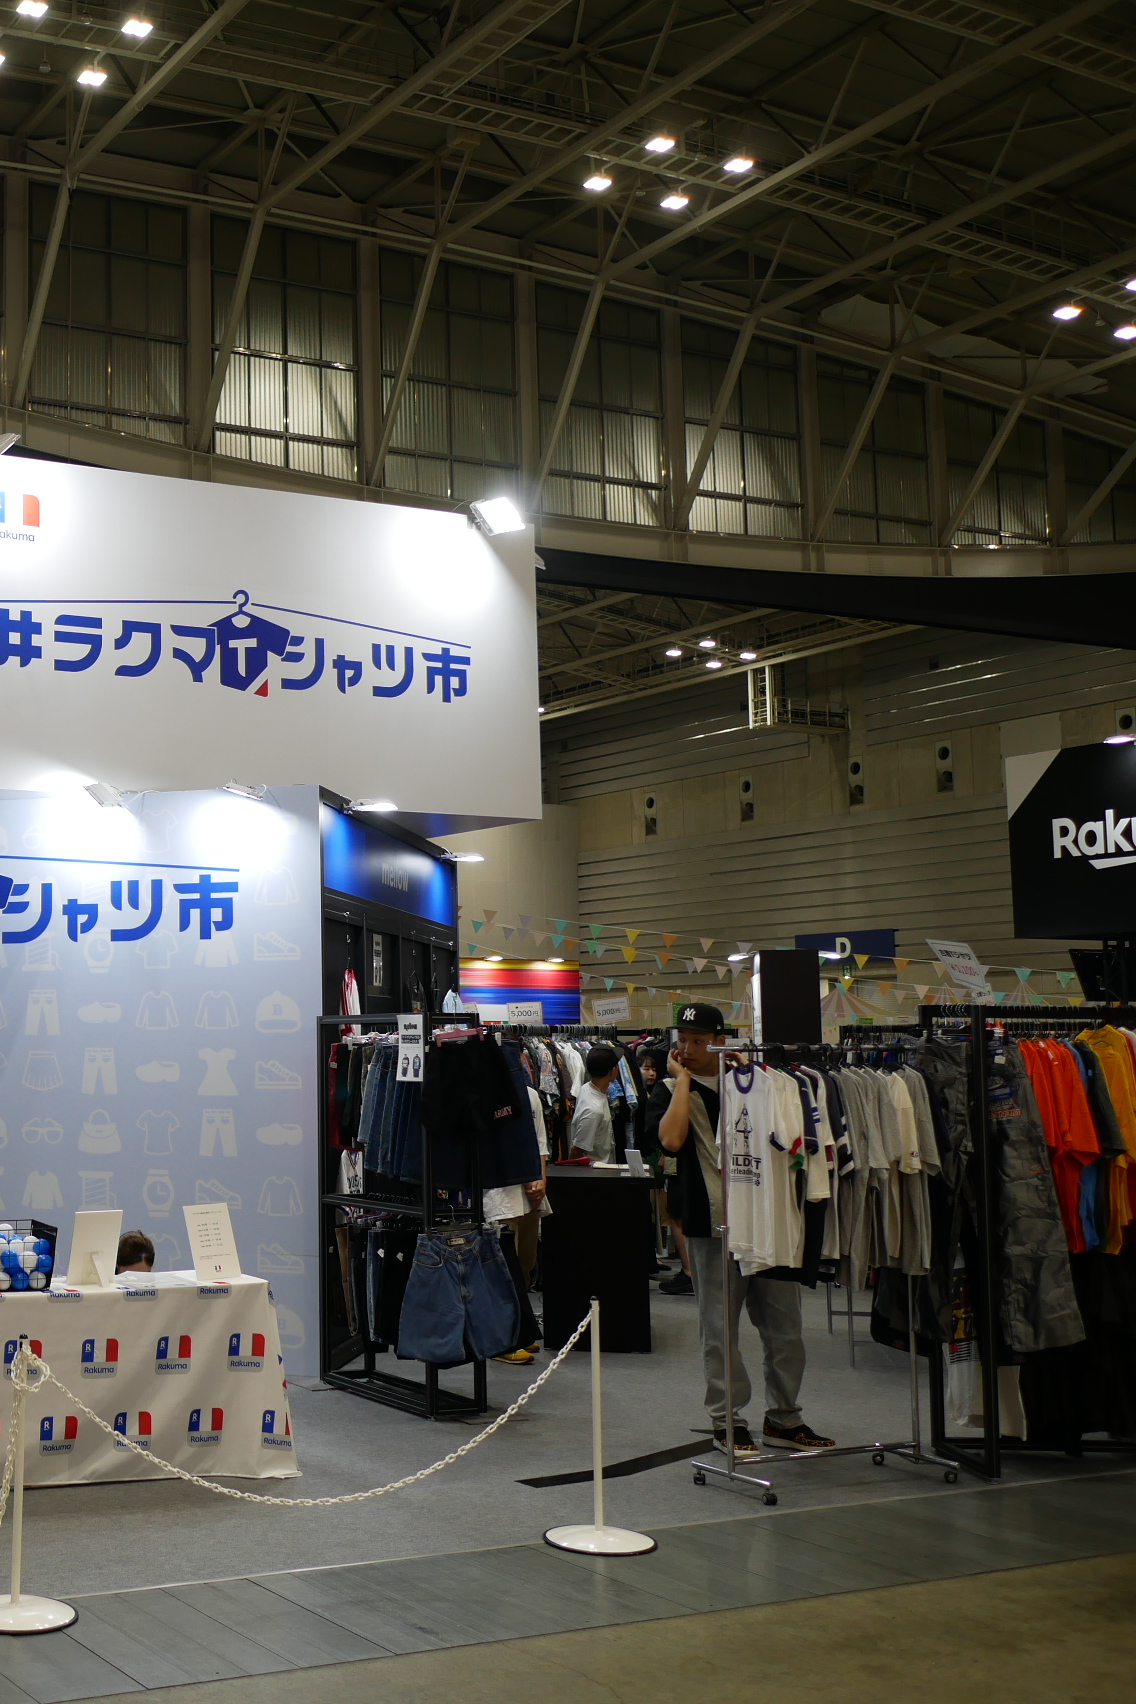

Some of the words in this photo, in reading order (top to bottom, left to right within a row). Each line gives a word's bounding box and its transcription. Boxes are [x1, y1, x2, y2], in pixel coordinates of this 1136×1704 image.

[381, 861, 409, 892] mellow
[835, 936, 852, 959] D
[510, 1009, 539, 1018] 5,000円
[126, 1289, 156, 1297] Rakuma
[199, 1286, 229, 1295] Rakuma
[157, 1362, 188, 1371] Rakuma
[230, 1360, 261, 1368] Rakuma
[83, 1366, 115, 1374] Rakuma
[190, 1435, 219, 1443] Rakuma
[264, 1437, 292, 1446] Rakuma
[42, 1444, 72, 1452] Rakuma
